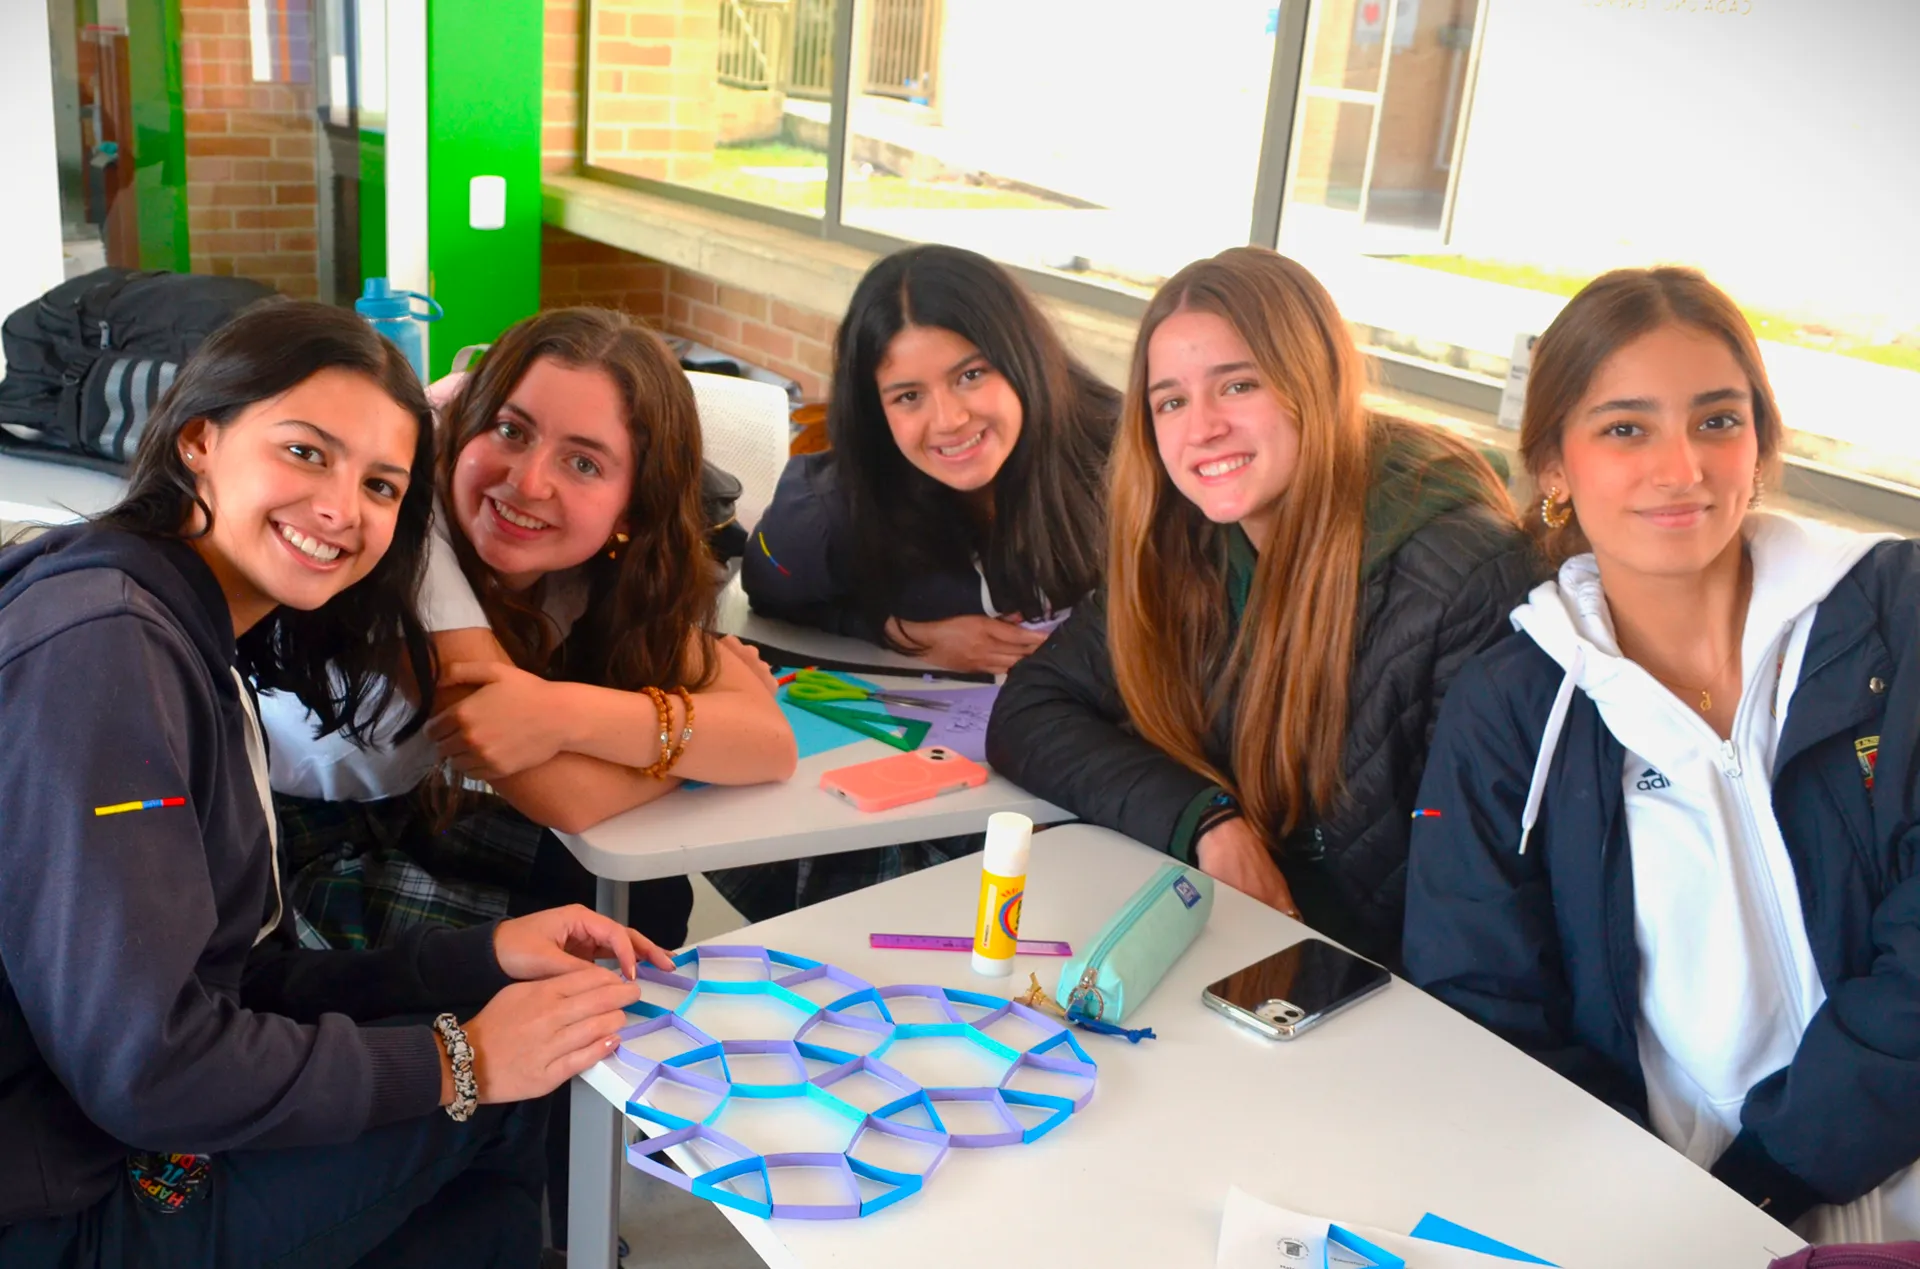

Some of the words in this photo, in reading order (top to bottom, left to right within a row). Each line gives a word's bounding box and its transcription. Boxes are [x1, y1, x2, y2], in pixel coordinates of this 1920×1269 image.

[1636, 773, 1671, 791] adi
[165, 1152, 196, 1169] DA
[131, 1169, 185, 1207] HAPPY
